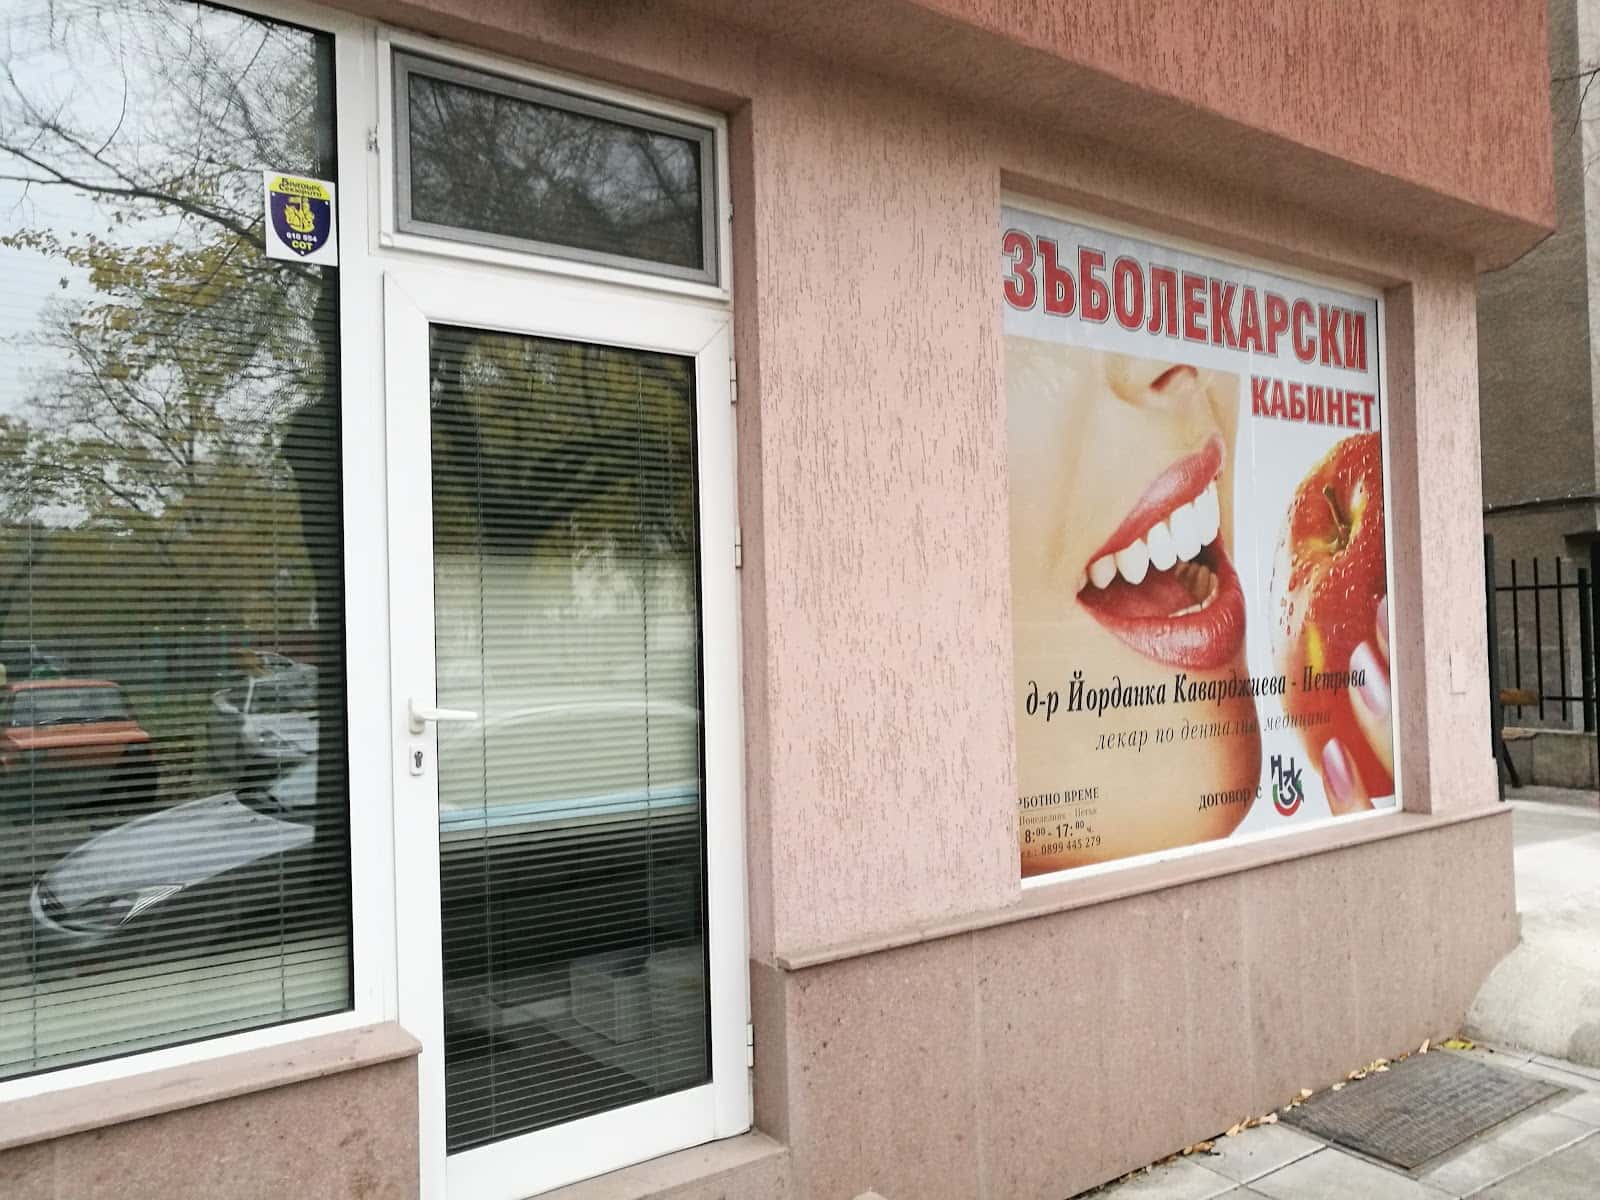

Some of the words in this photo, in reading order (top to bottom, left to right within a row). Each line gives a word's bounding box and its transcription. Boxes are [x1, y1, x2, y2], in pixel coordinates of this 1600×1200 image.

[1001, 228, 1368, 373] ЗЪБОЛЕКАРСКИ
[1250, 374, 1375, 430] КАБИНЕТ
[1026, 680, 1059, 722] д-р
[1067, 670, 1166, 717] Йорданка
[1173, 668, 1286, 706] Каварджиева
[1302, 666, 1366, 695] Петрова
[1096, 727, 1148, 752] лекар
[1155, 726, 1174, 744] по
[1264, 708, 1331, 732] медицина
[1064, 787, 1099, 804] ВРЕМЕ
[1198, 787, 1251, 812] договор
[1085, 835, 1101, 848] 279
